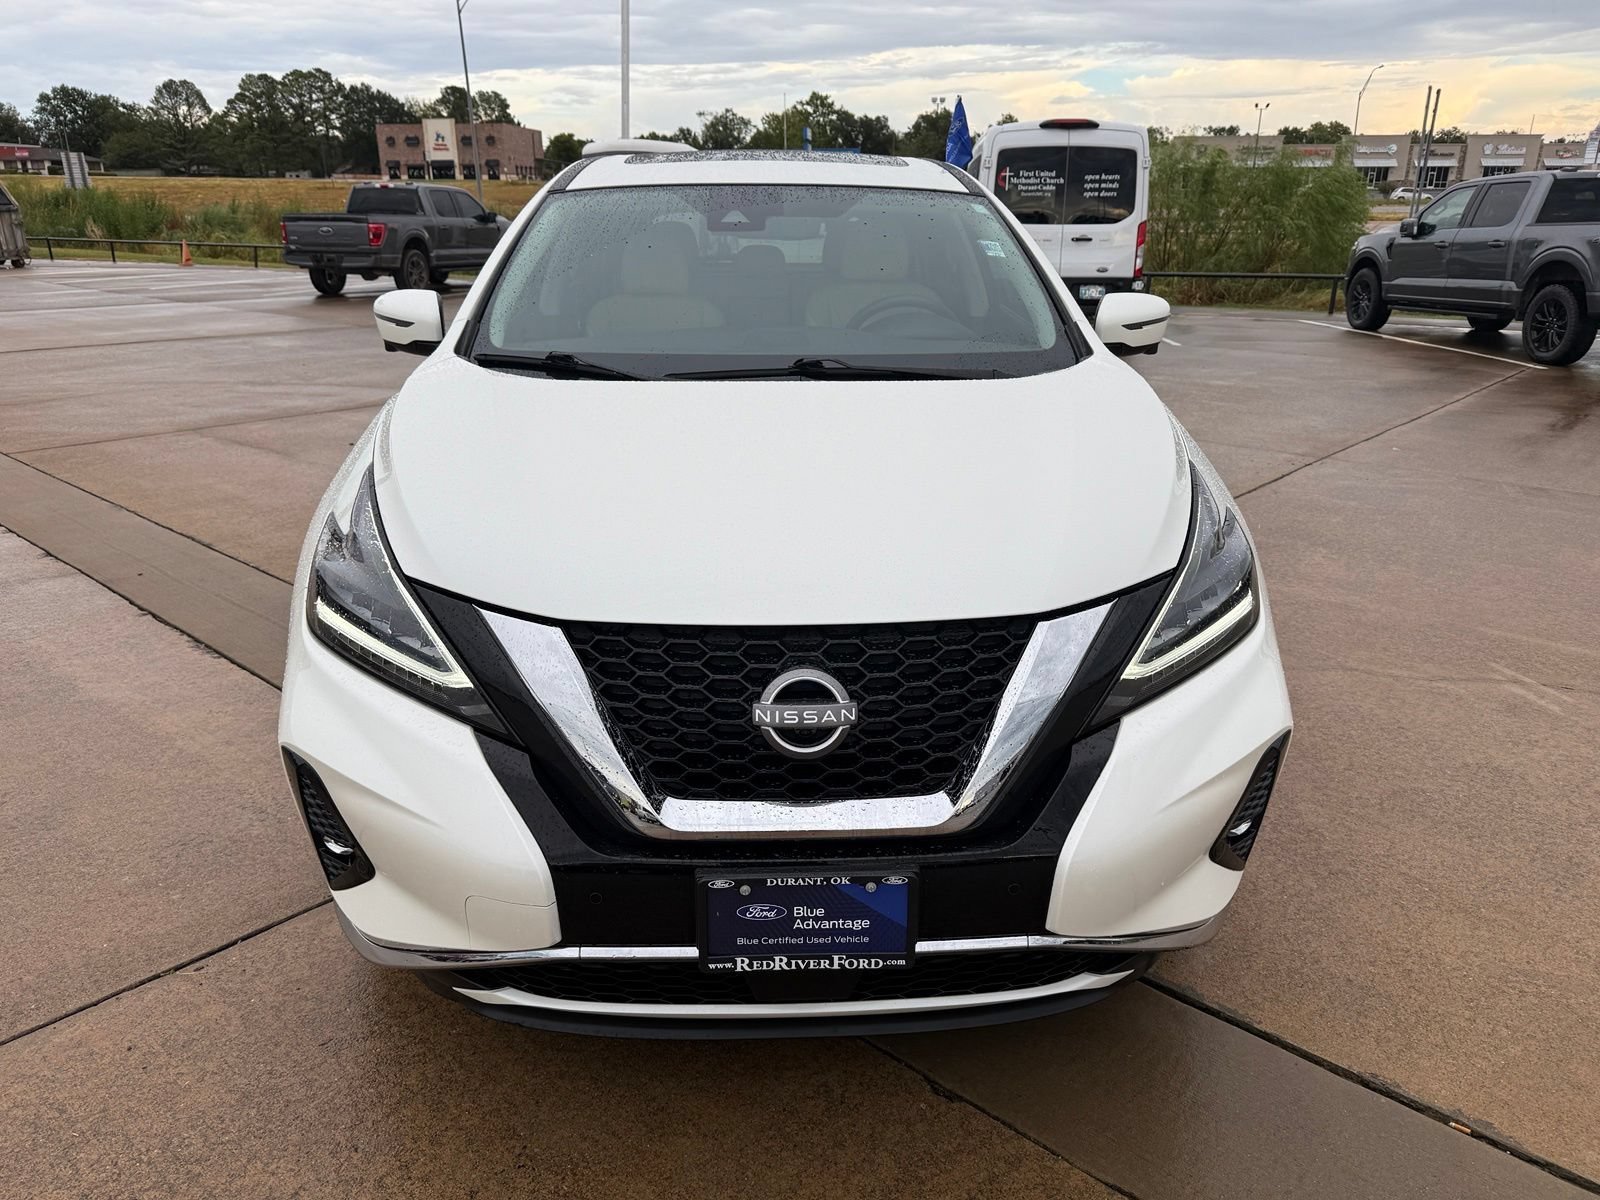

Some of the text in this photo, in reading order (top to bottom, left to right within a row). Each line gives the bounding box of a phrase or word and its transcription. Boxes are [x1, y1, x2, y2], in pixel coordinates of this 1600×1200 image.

[1084, 182, 1099, 190] open
[755, 707, 856, 724] NISSAN
[830, 876, 852, 885] OK
[793, 906, 825, 917] Blue
[793, 918, 870, 931] Advantage
[737, 935, 870, 945] Blue Certified Used Vehicle
